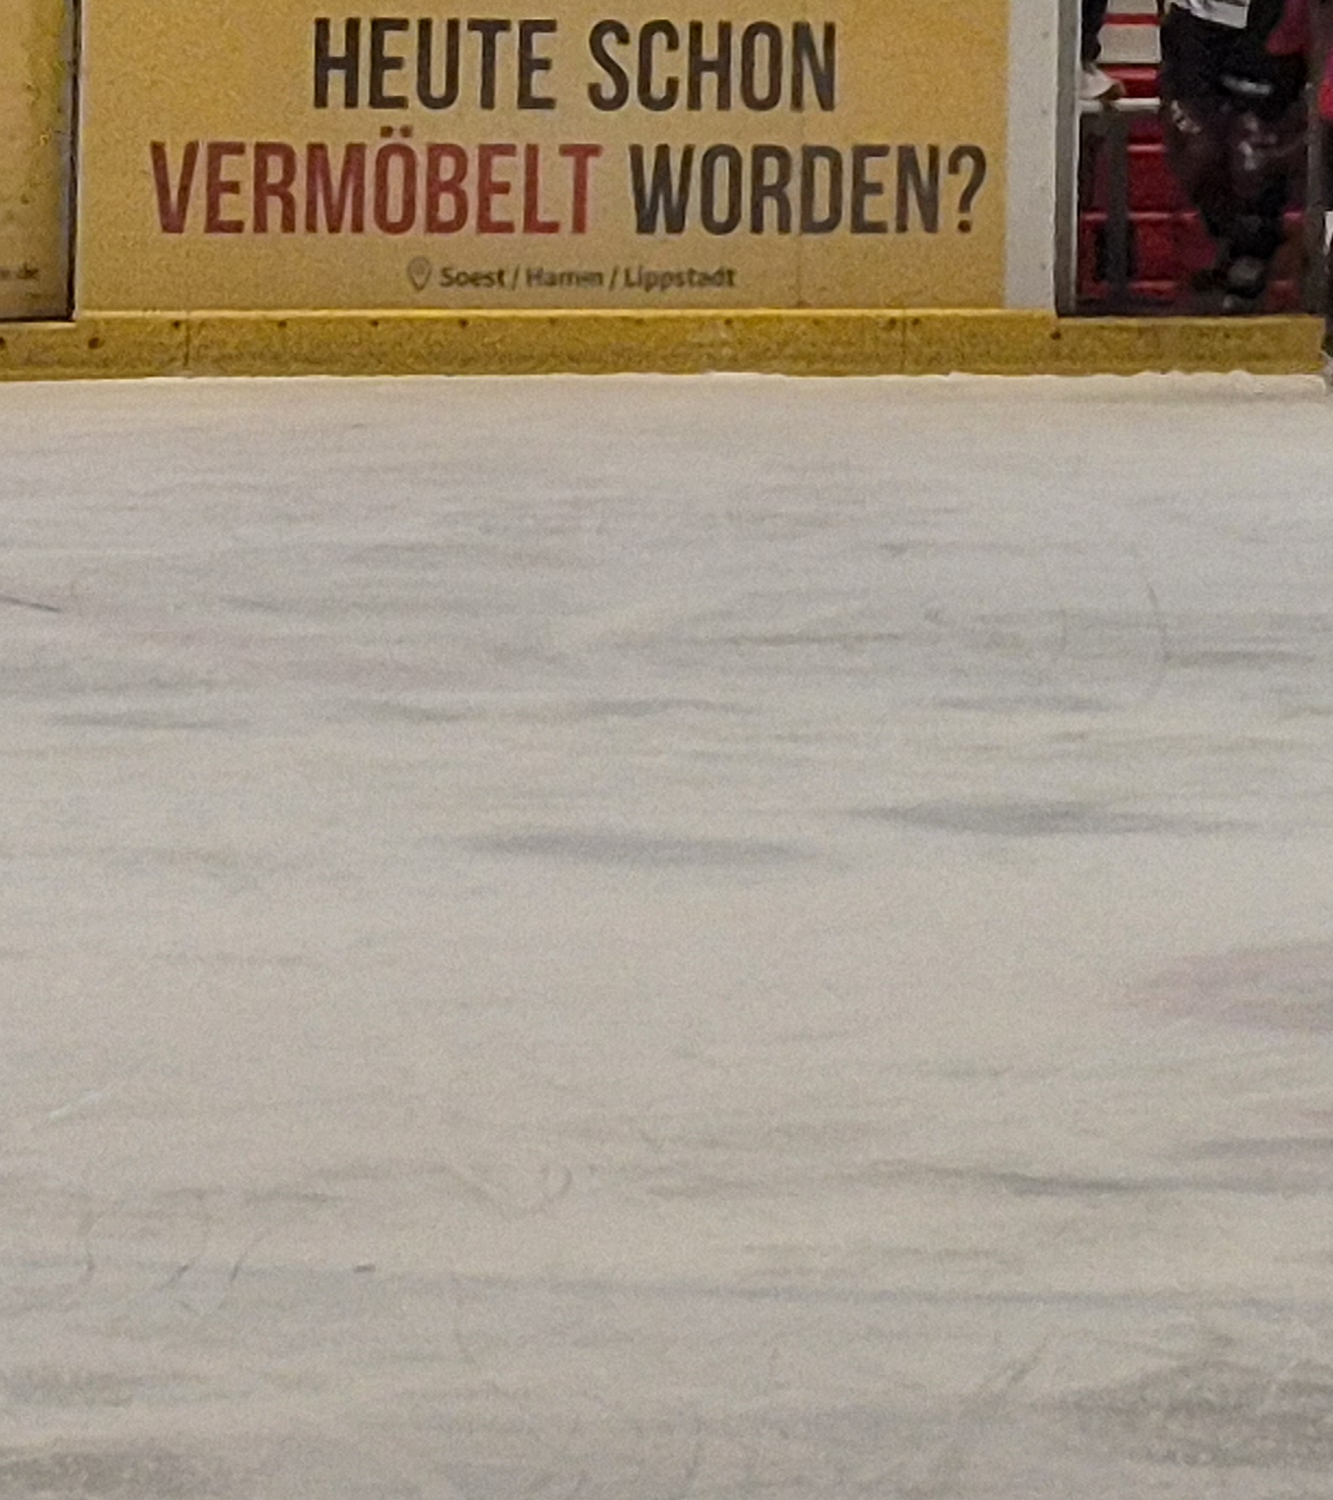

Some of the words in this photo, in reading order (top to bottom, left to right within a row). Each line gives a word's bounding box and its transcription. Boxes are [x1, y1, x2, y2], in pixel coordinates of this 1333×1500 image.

[312, 17, 558, 110] HEUTE
[586, 18, 838, 112] SCHON
[149, 125, 603, 236] VERMÖBELT
[629, 142, 989, 236] WORDEN?
[440, 264, 506, 289] Soest
[526, 266, 604, 289] Hamm
[623, 265, 736, 293] Lippstadt
